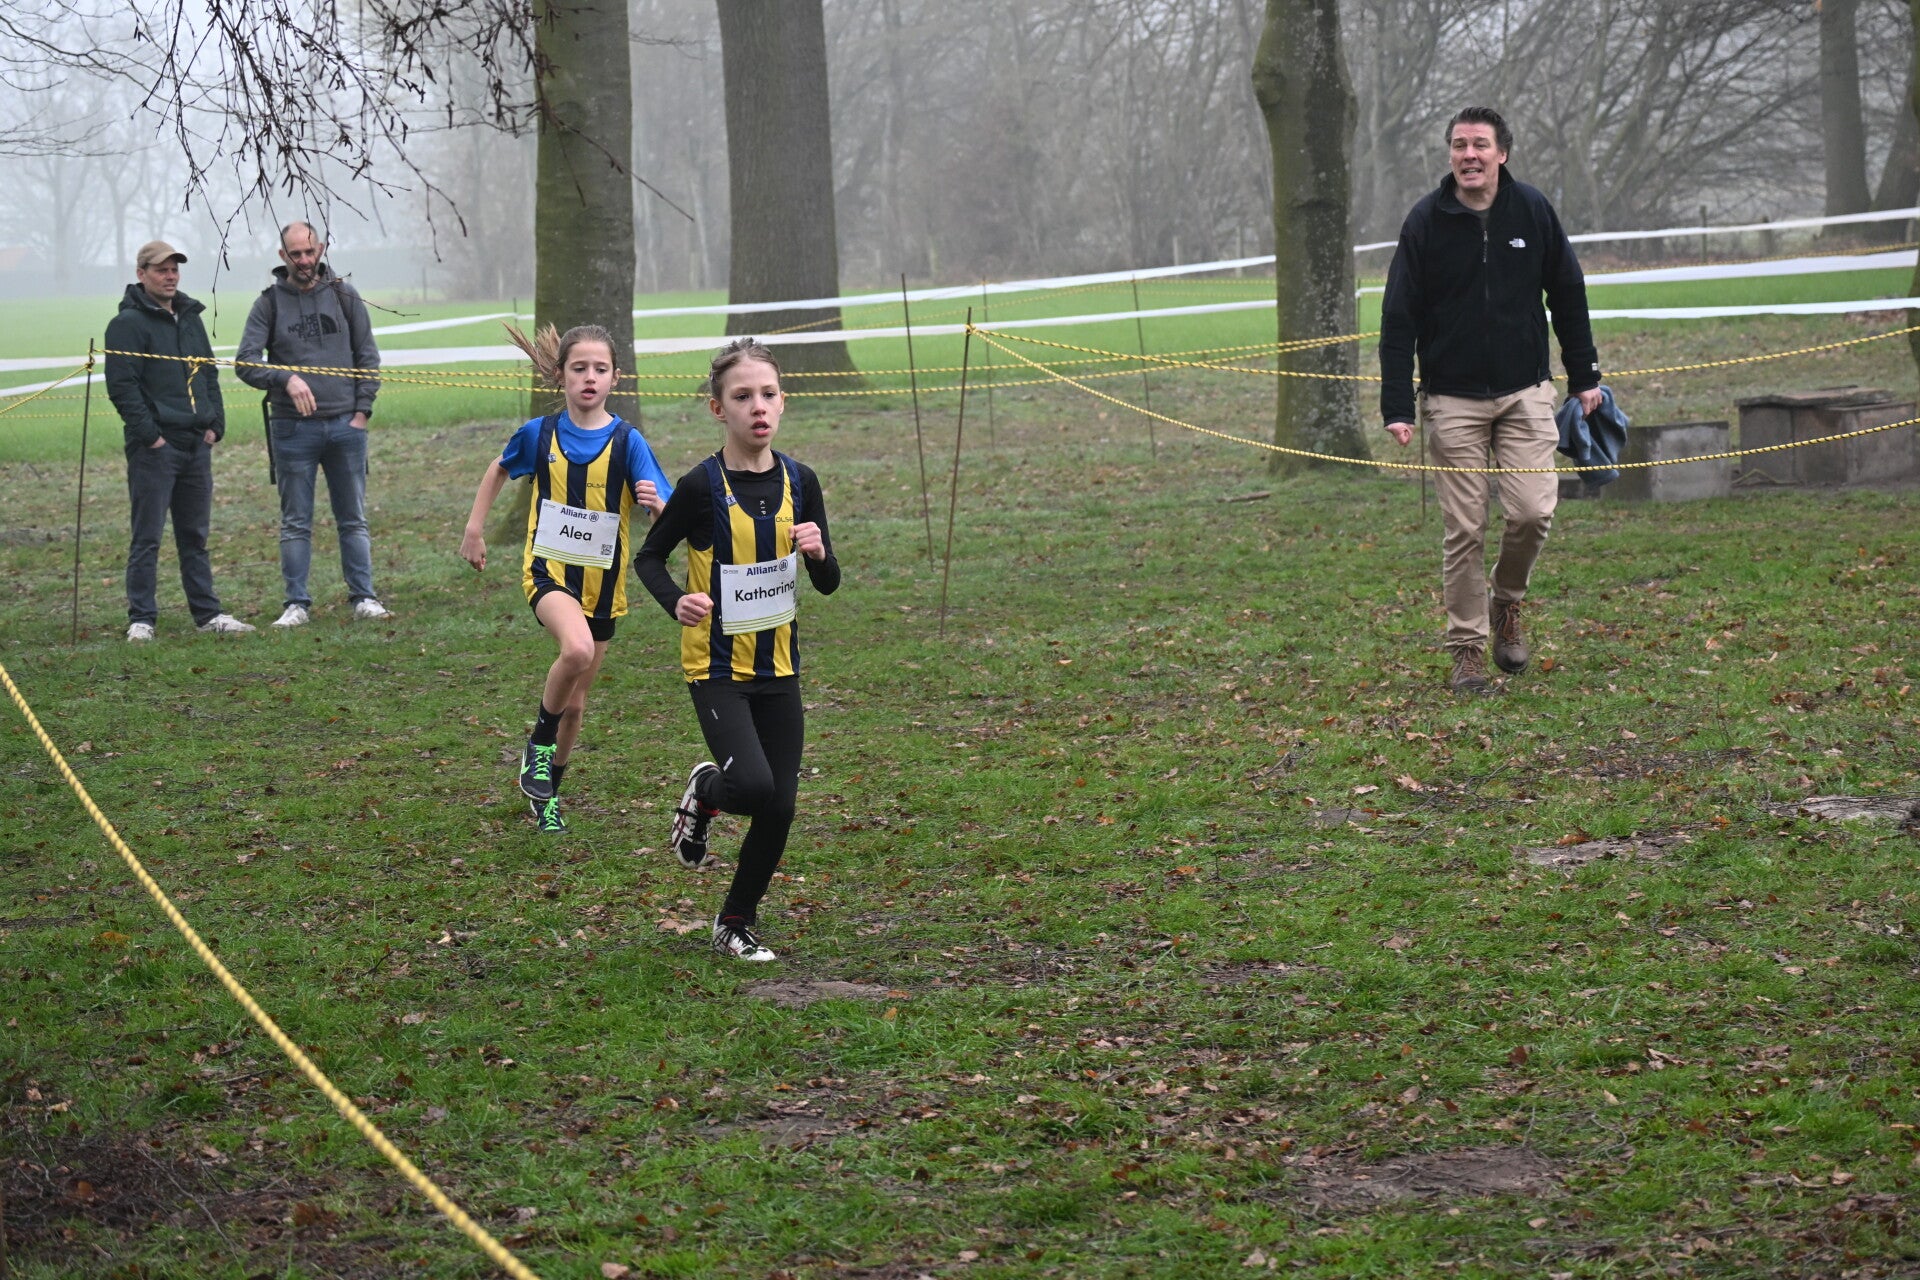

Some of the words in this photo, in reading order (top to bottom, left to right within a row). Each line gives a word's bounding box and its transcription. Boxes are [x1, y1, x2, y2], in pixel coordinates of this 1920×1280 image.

[560, 507, 588, 520] Allianz
[559, 524, 593, 542] Alea
[746, 564, 778, 577] Allianz
[734, 580, 795, 602] Katharina
